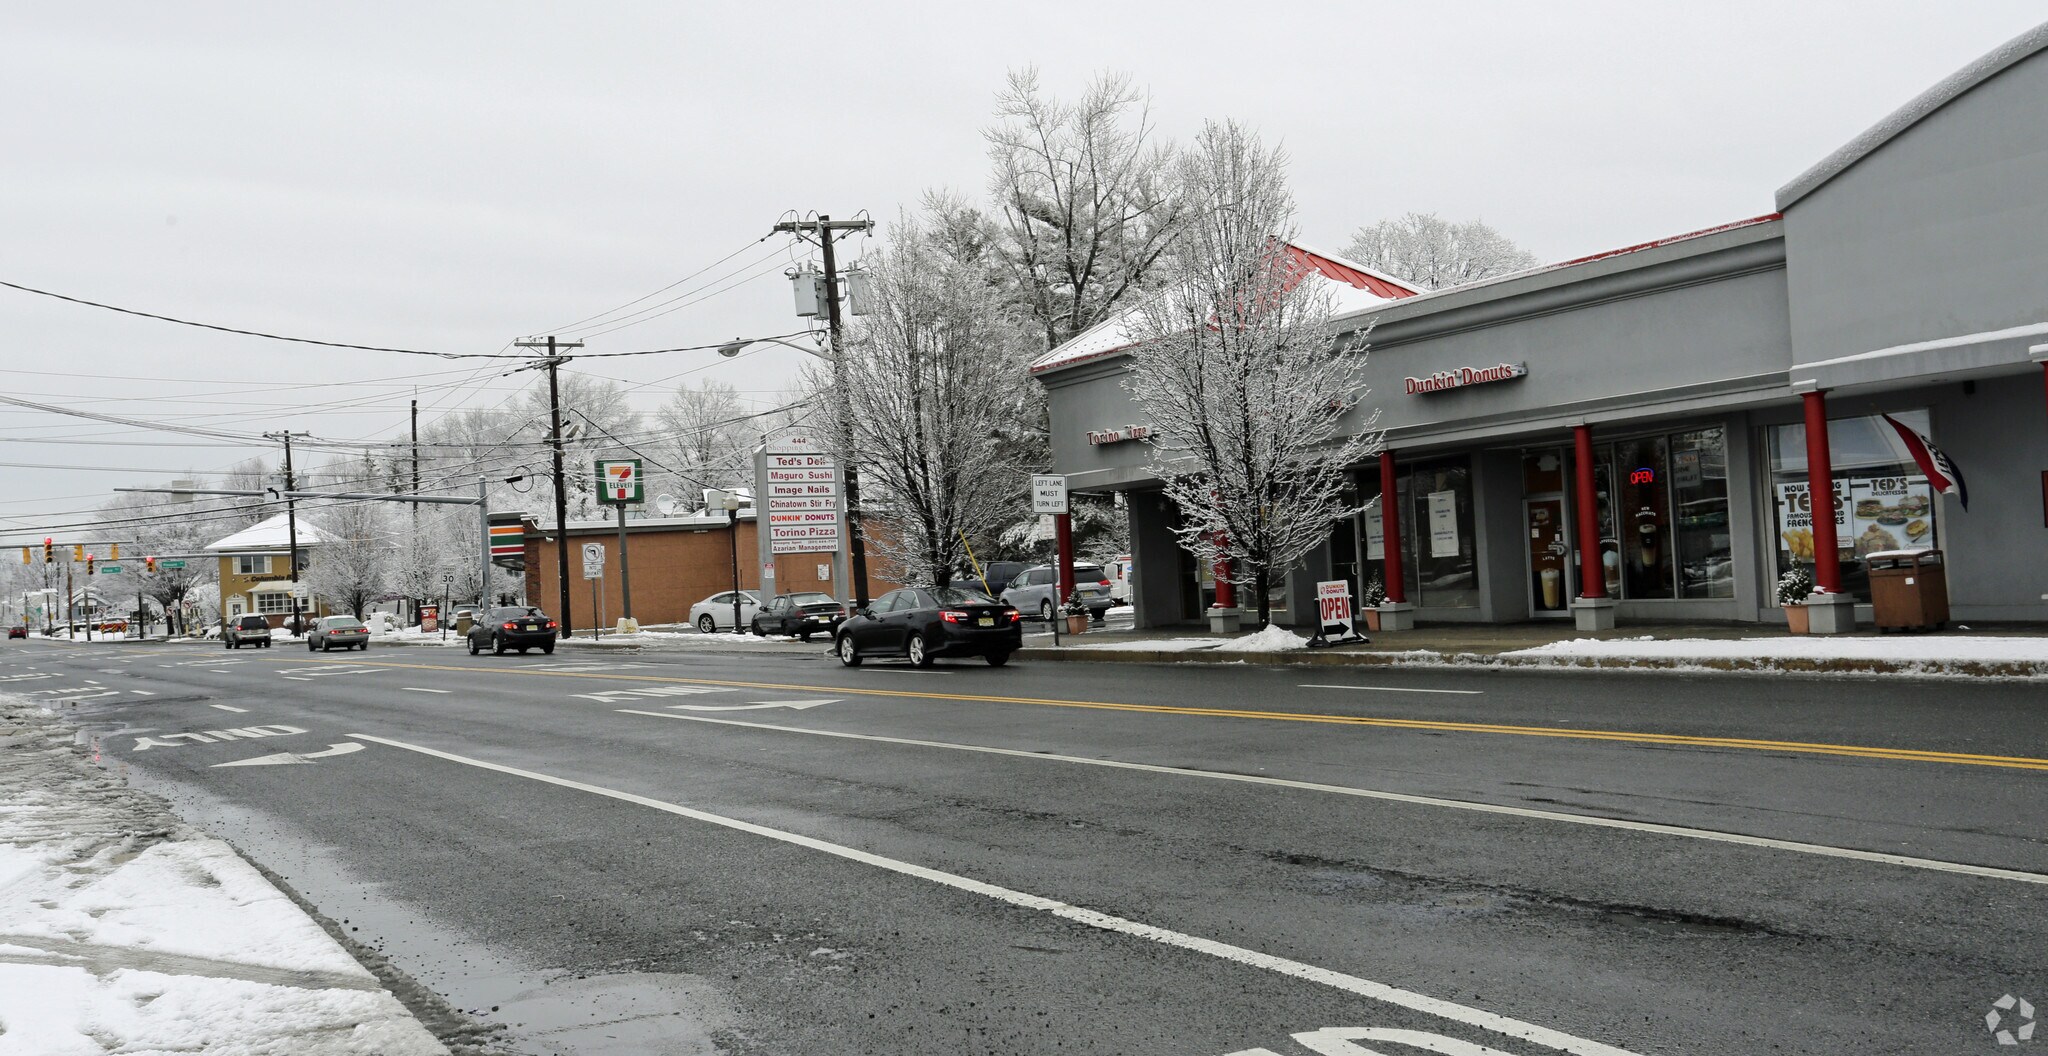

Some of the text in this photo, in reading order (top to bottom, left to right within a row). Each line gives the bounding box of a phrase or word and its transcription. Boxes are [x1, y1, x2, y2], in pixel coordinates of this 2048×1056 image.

[1405, 365, 1512, 395] Dunkin' Donuts
[1086, 431, 1120, 446] Torino
[768, 444, 804, 453] Shopping
[776, 457, 802, 466] Ted's
[770, 471, 833, 481] Maguro Sushi
[1630, 471, 1653, 484] OPEN
[609, 466, 632, 498] 7
[1870, 478, 1908, 491] TED'S
[774, 485, 830, 495] Image Nails
[1784, 484, 1805, 493] NOW
[770, 500, 807, 508] Chinatown
[825, 500, 837, 508] Fry
[1787, 519, 1813, 527] FRENC
[773, 527, 836, 537] Torino Pizza
[443, 575, 454, 583] 30
[1321, 597, 1350, 621] OPEN
[132, 724, 309, 751] ONLY
